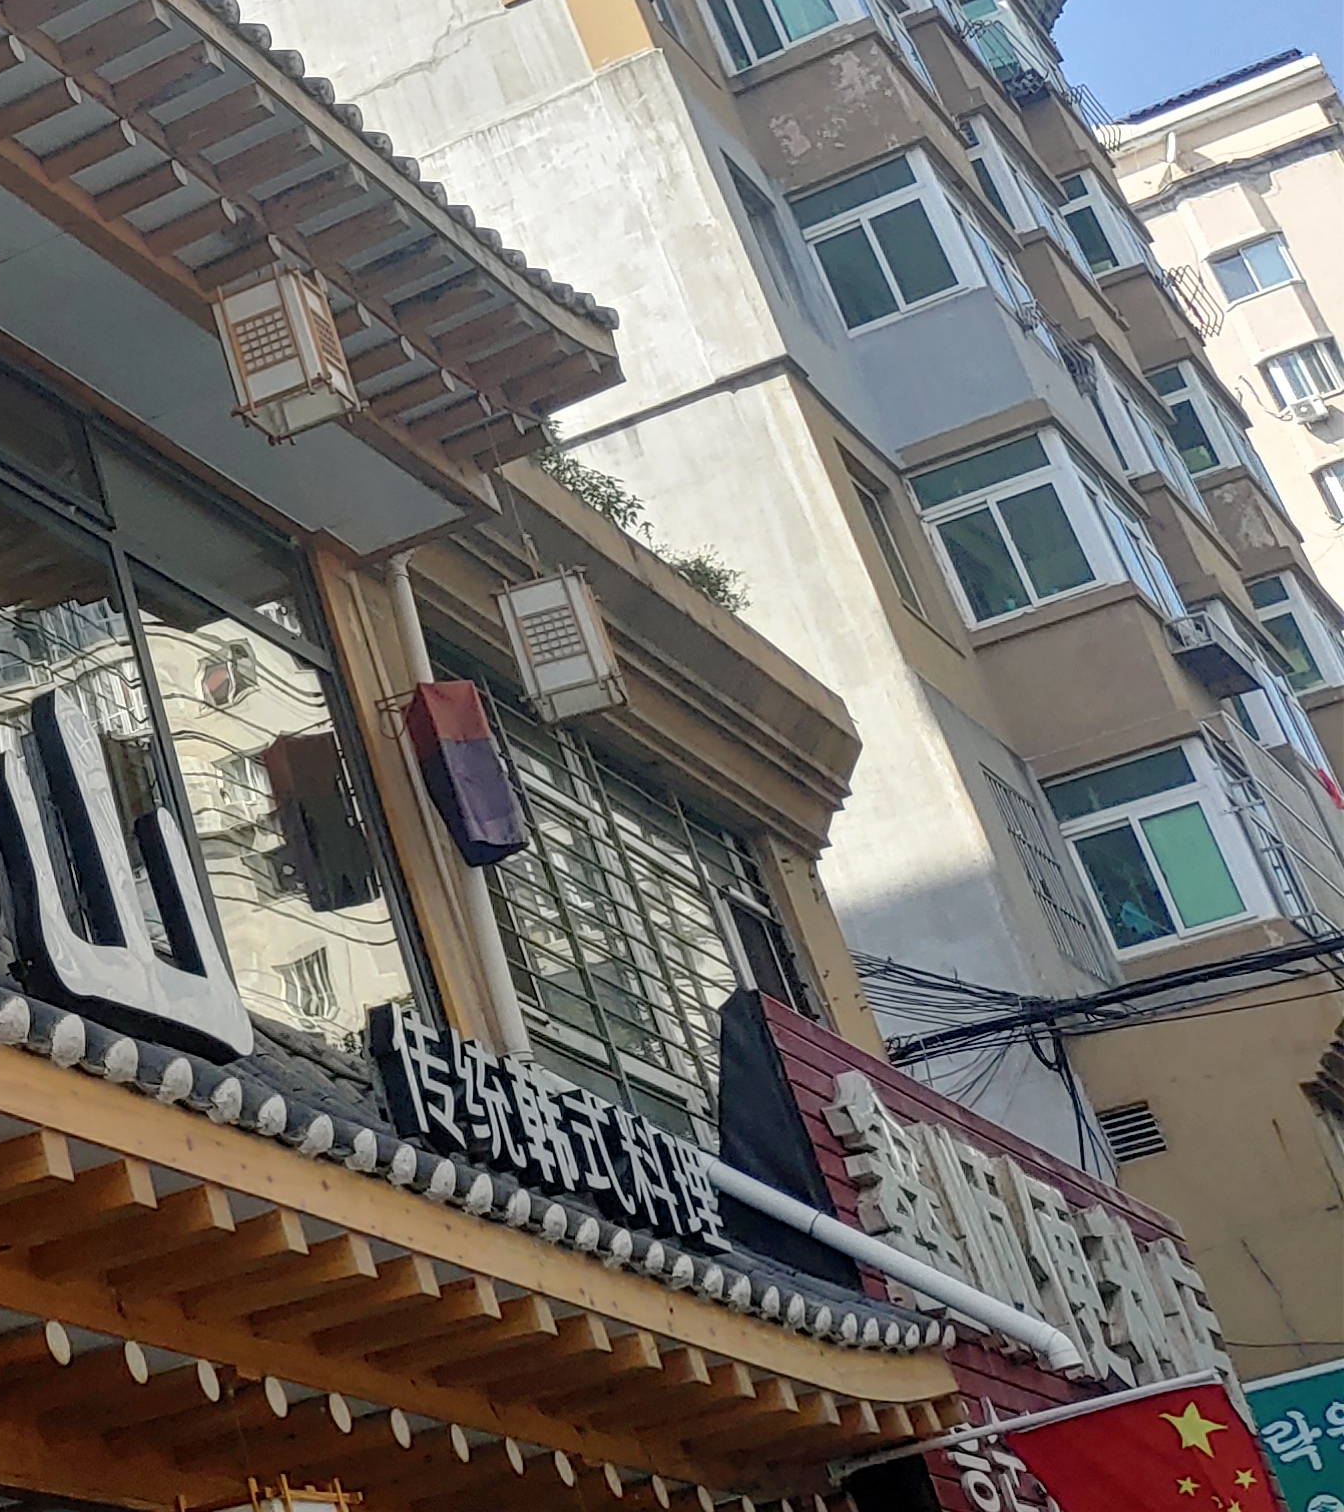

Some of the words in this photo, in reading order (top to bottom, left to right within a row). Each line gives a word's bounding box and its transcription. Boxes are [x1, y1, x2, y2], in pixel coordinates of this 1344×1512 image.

[386, 1001, 732, 1253] 传统韩式料理
